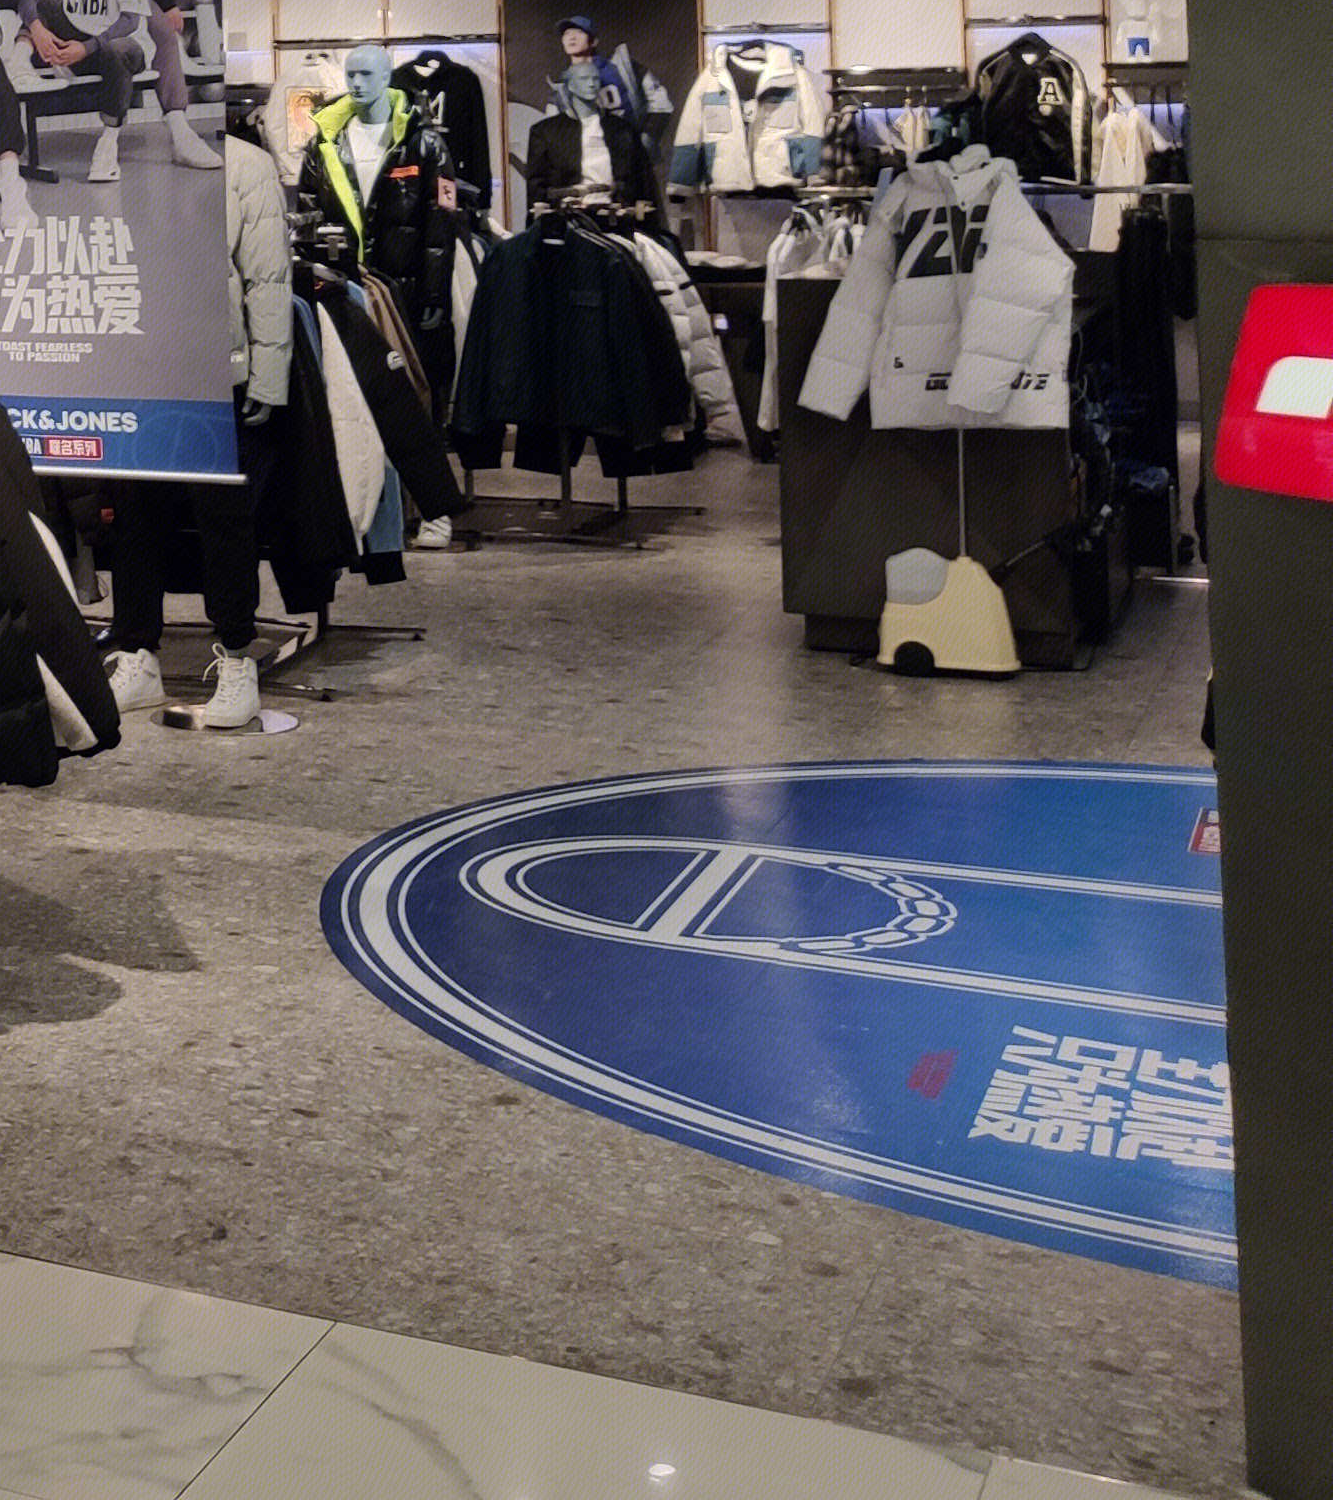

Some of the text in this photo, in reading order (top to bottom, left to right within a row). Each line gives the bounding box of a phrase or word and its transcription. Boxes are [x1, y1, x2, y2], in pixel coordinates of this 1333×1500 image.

[35, 341, 93, 354] FEARLESS
[8, 351, 81, 363] TO PASSION
[7, 407, 139, 433] CK&JONES
